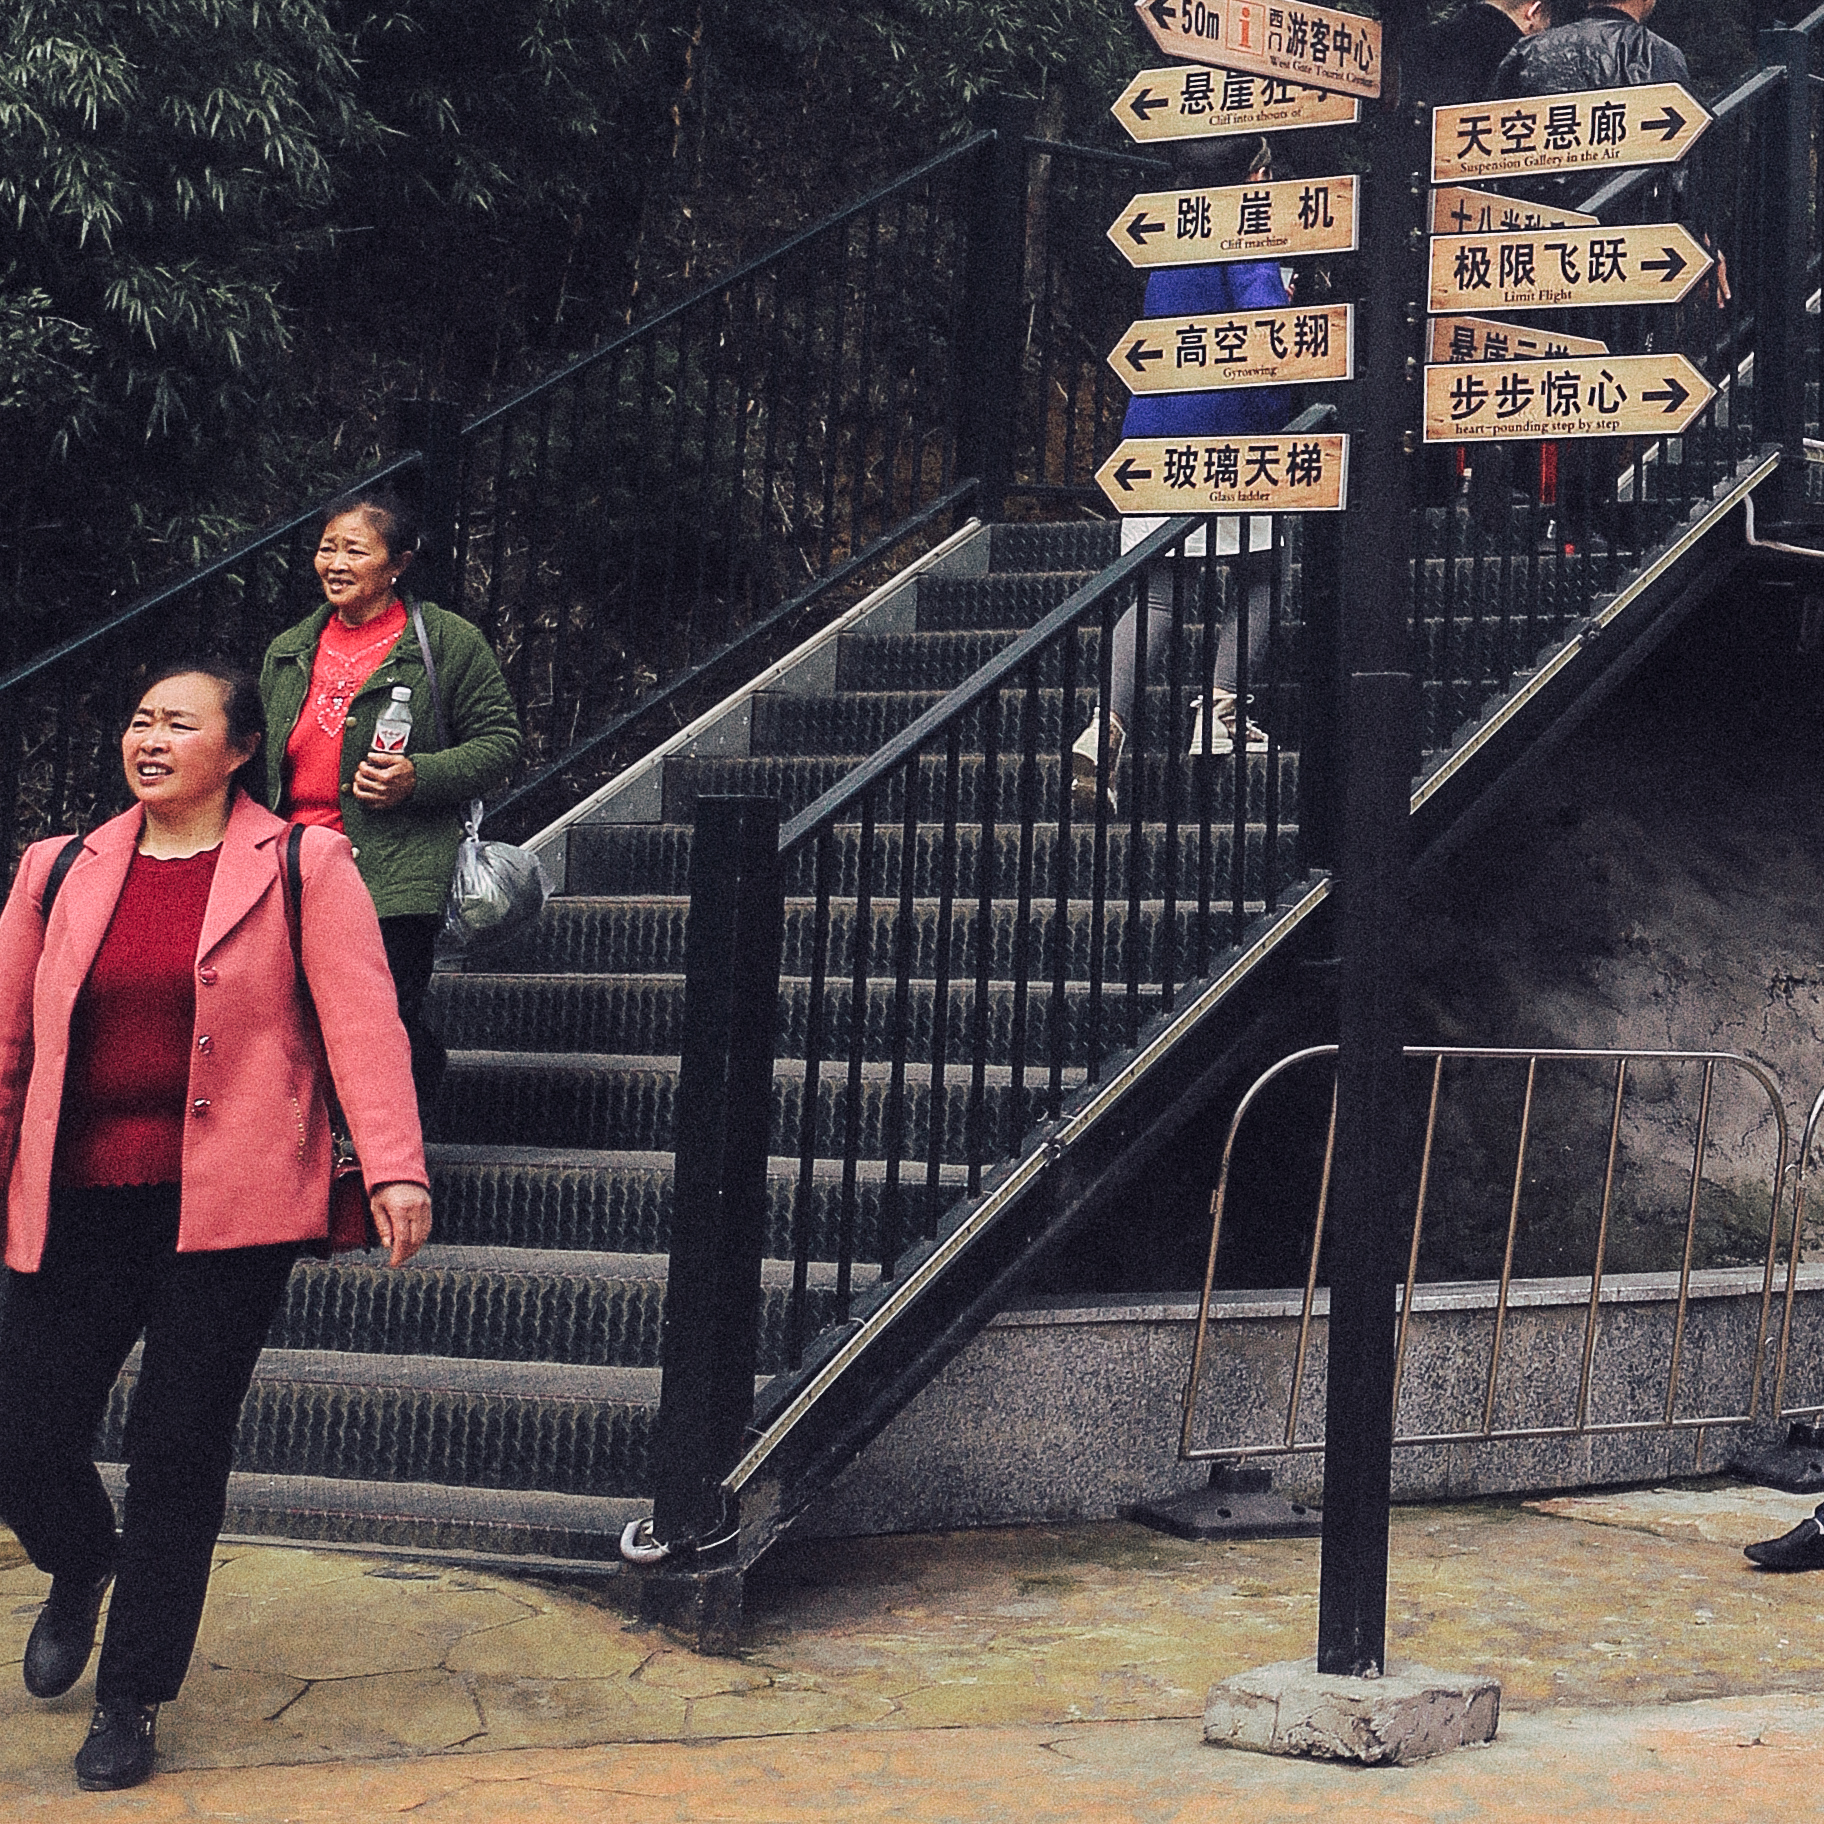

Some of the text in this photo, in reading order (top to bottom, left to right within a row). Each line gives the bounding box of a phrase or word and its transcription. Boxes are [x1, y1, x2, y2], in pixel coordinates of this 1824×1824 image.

[1286, 11, 1374, 73] 游客中心
[1179, 70, 1328, 115] 悬崖狂
[1456, 99, 1628, 160] 天空悬廊
[1459, 147, 1621, 176] Suspension Gallery in the Air
[1175, 185, 1335, 241] 跳崖机
[1220, 237, 1244, 251] Cliff
[1453, 236, 1628, 291] 极限飞跃
[1503, 288, 1573, 303] Limit Flight
[1175, 313, 1329, 369] 高空飞翔
[1449, 368, 1628, 421] 步步惊心
[1552, 420, 1576, 434] step
[1577, 417, 1593, 432] by
[1595, 418, 1621, 432] step
[1162, 441, 1323, 490] 玻璃天梯
[1208, 490, 1236, 503] Glass
